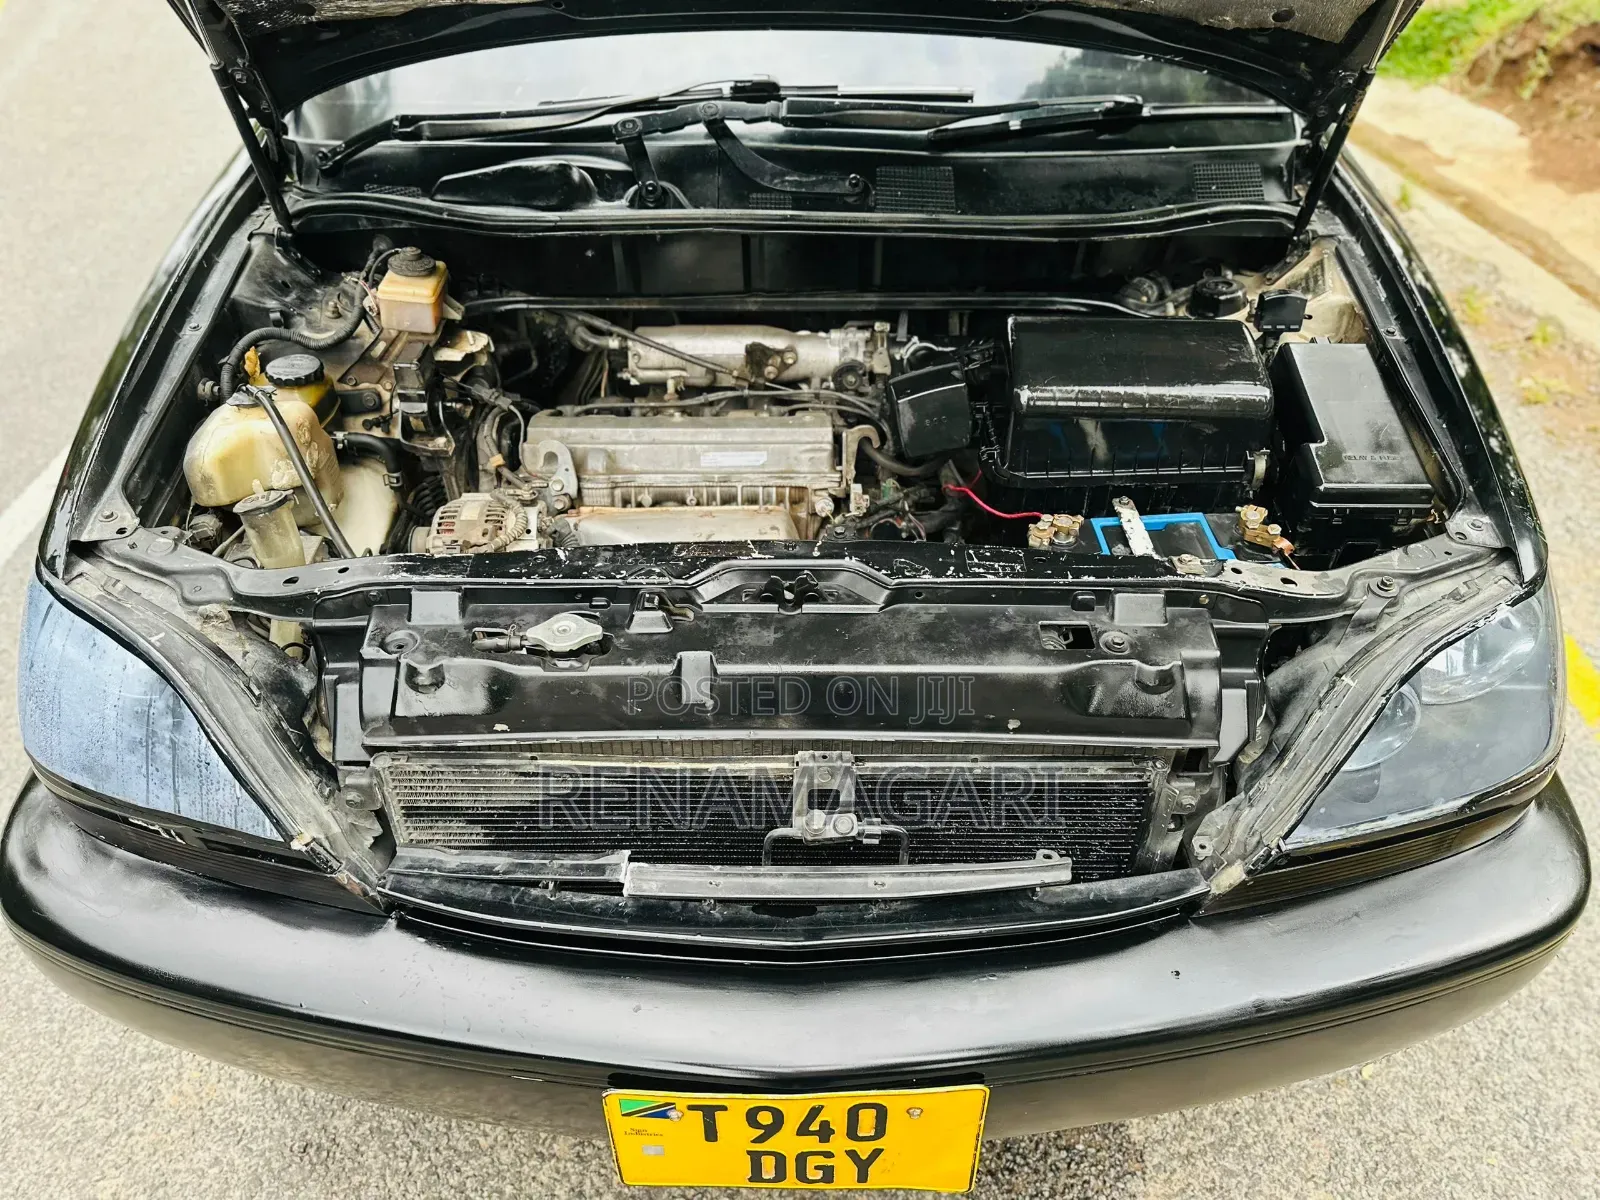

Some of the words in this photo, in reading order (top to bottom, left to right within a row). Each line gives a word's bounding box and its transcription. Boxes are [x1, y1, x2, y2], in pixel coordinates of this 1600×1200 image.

[687, 1105, 728, 1142] T
[746, 1103, 887, 1143] 940
[747, 1148, 885, 1185] DGY
